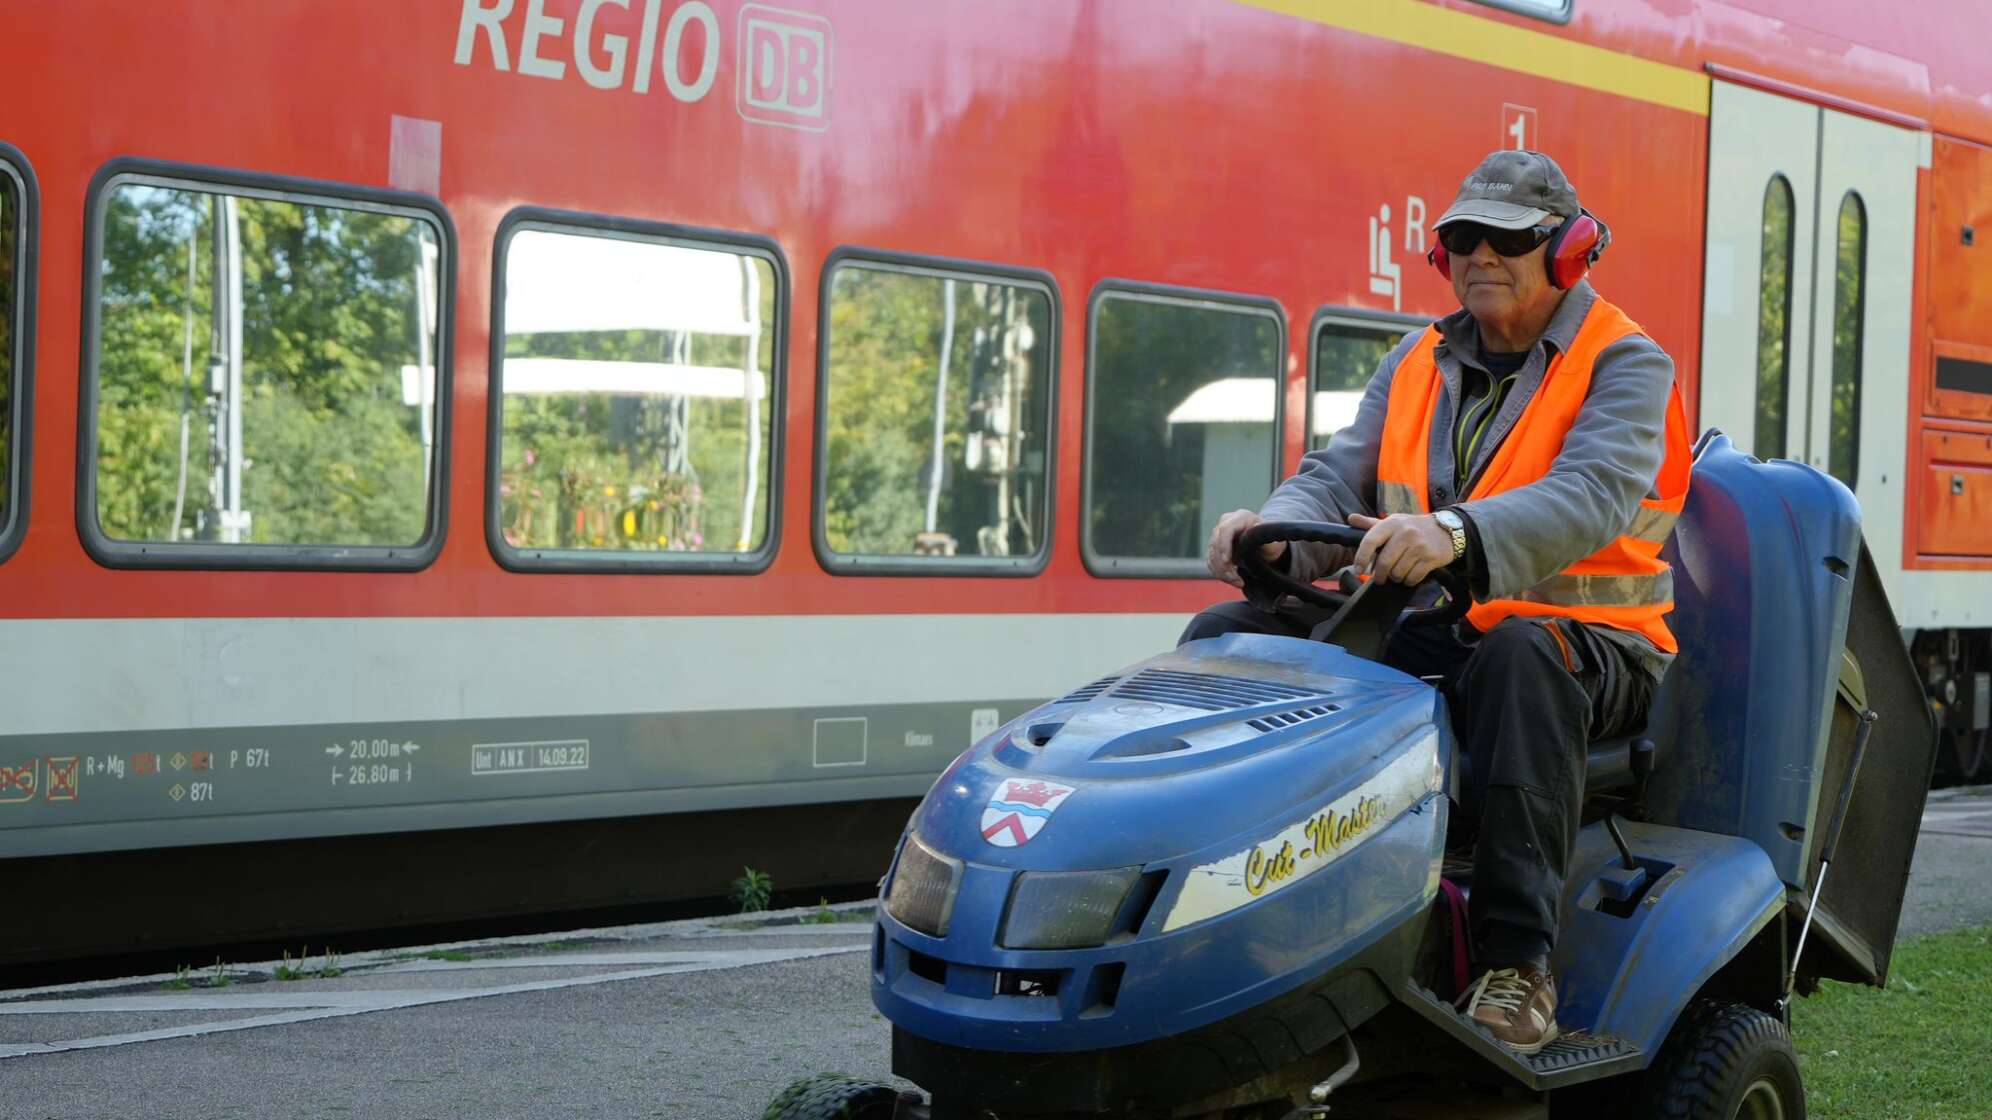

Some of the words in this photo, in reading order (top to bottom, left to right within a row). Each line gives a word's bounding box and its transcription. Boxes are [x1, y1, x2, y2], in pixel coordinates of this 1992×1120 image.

[453, 0, 720, 103] REGIO
[746, 19, 824, 117] DB
[1509, 114, 1525, 151] 1
[230, 750, 239, 768] P
[246, 748, 270, 767] 67t
[499, 749, 525, 767] ANX
[190, 783, 213, 801] 87t
